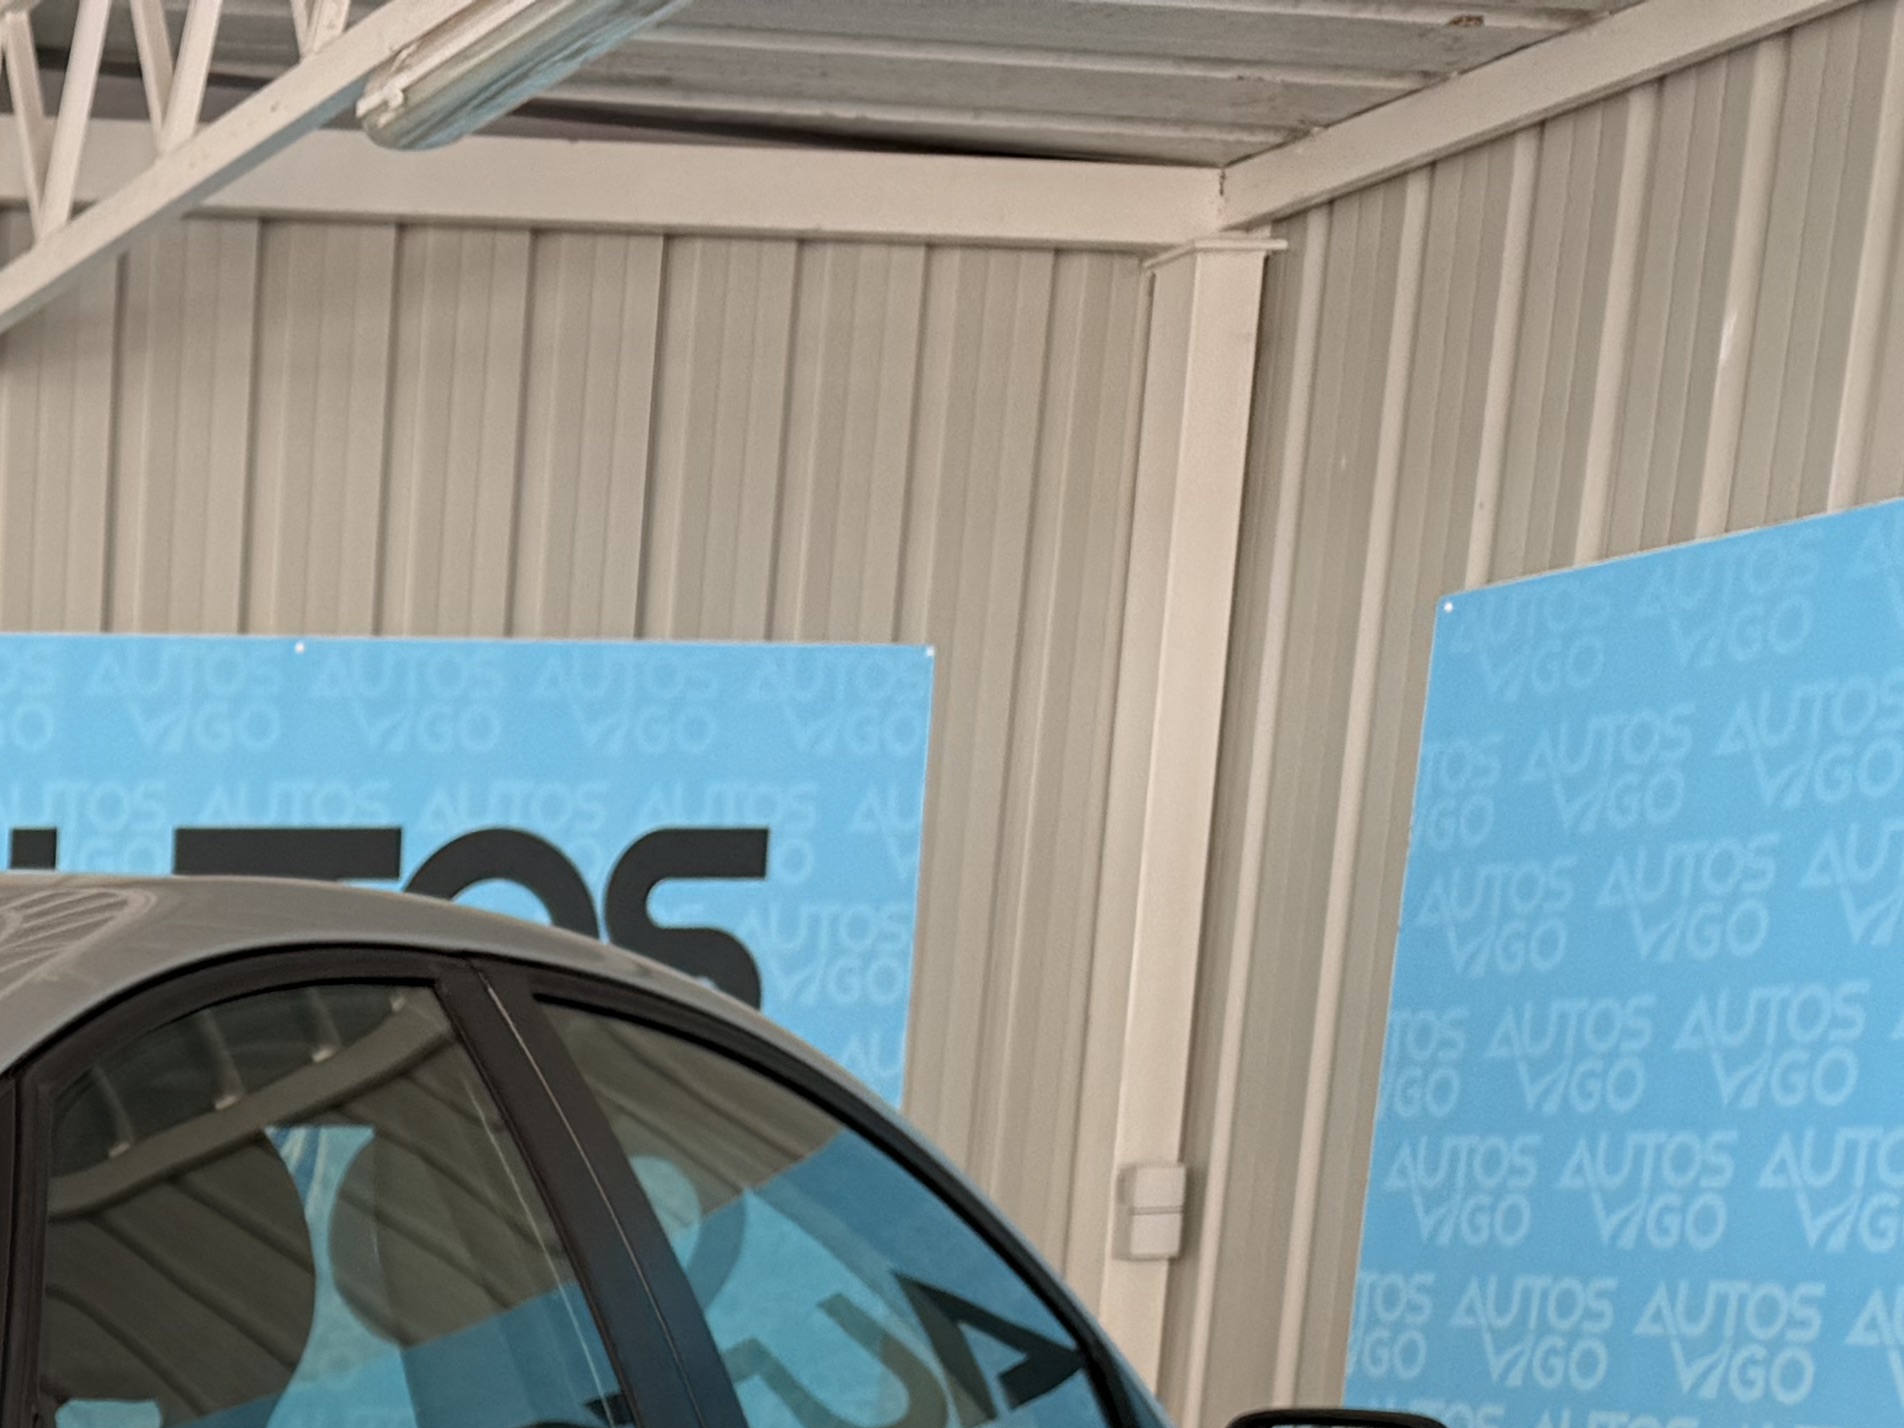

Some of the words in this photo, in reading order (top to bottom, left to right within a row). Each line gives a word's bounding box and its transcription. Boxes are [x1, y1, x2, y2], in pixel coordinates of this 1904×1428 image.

[84, 645, 282, 697] AUTOS
[308, 646, 505, 698] AUTOS
[532, 647, 720, 699] AUTOS
[745, 649, 927, 700] AUTOS
[1519, 703, 1696, 783] AUTOS
[1415, 854, 1578, 925] AUTOS
[1595, 830, 1781, 909] AUTOS
[1483, 993, 1658, 1059] AUTOS
[1673, 978, 1873, 1051] AUTOS
[1385, 1133, 1542, 1192] AUTOS
[1555, 1129, 1739, 1190] AUTOS
[1449, 1273, 1619, 1336] AUTOS
[1632, 1278, 1826, 1345] AUTOS
